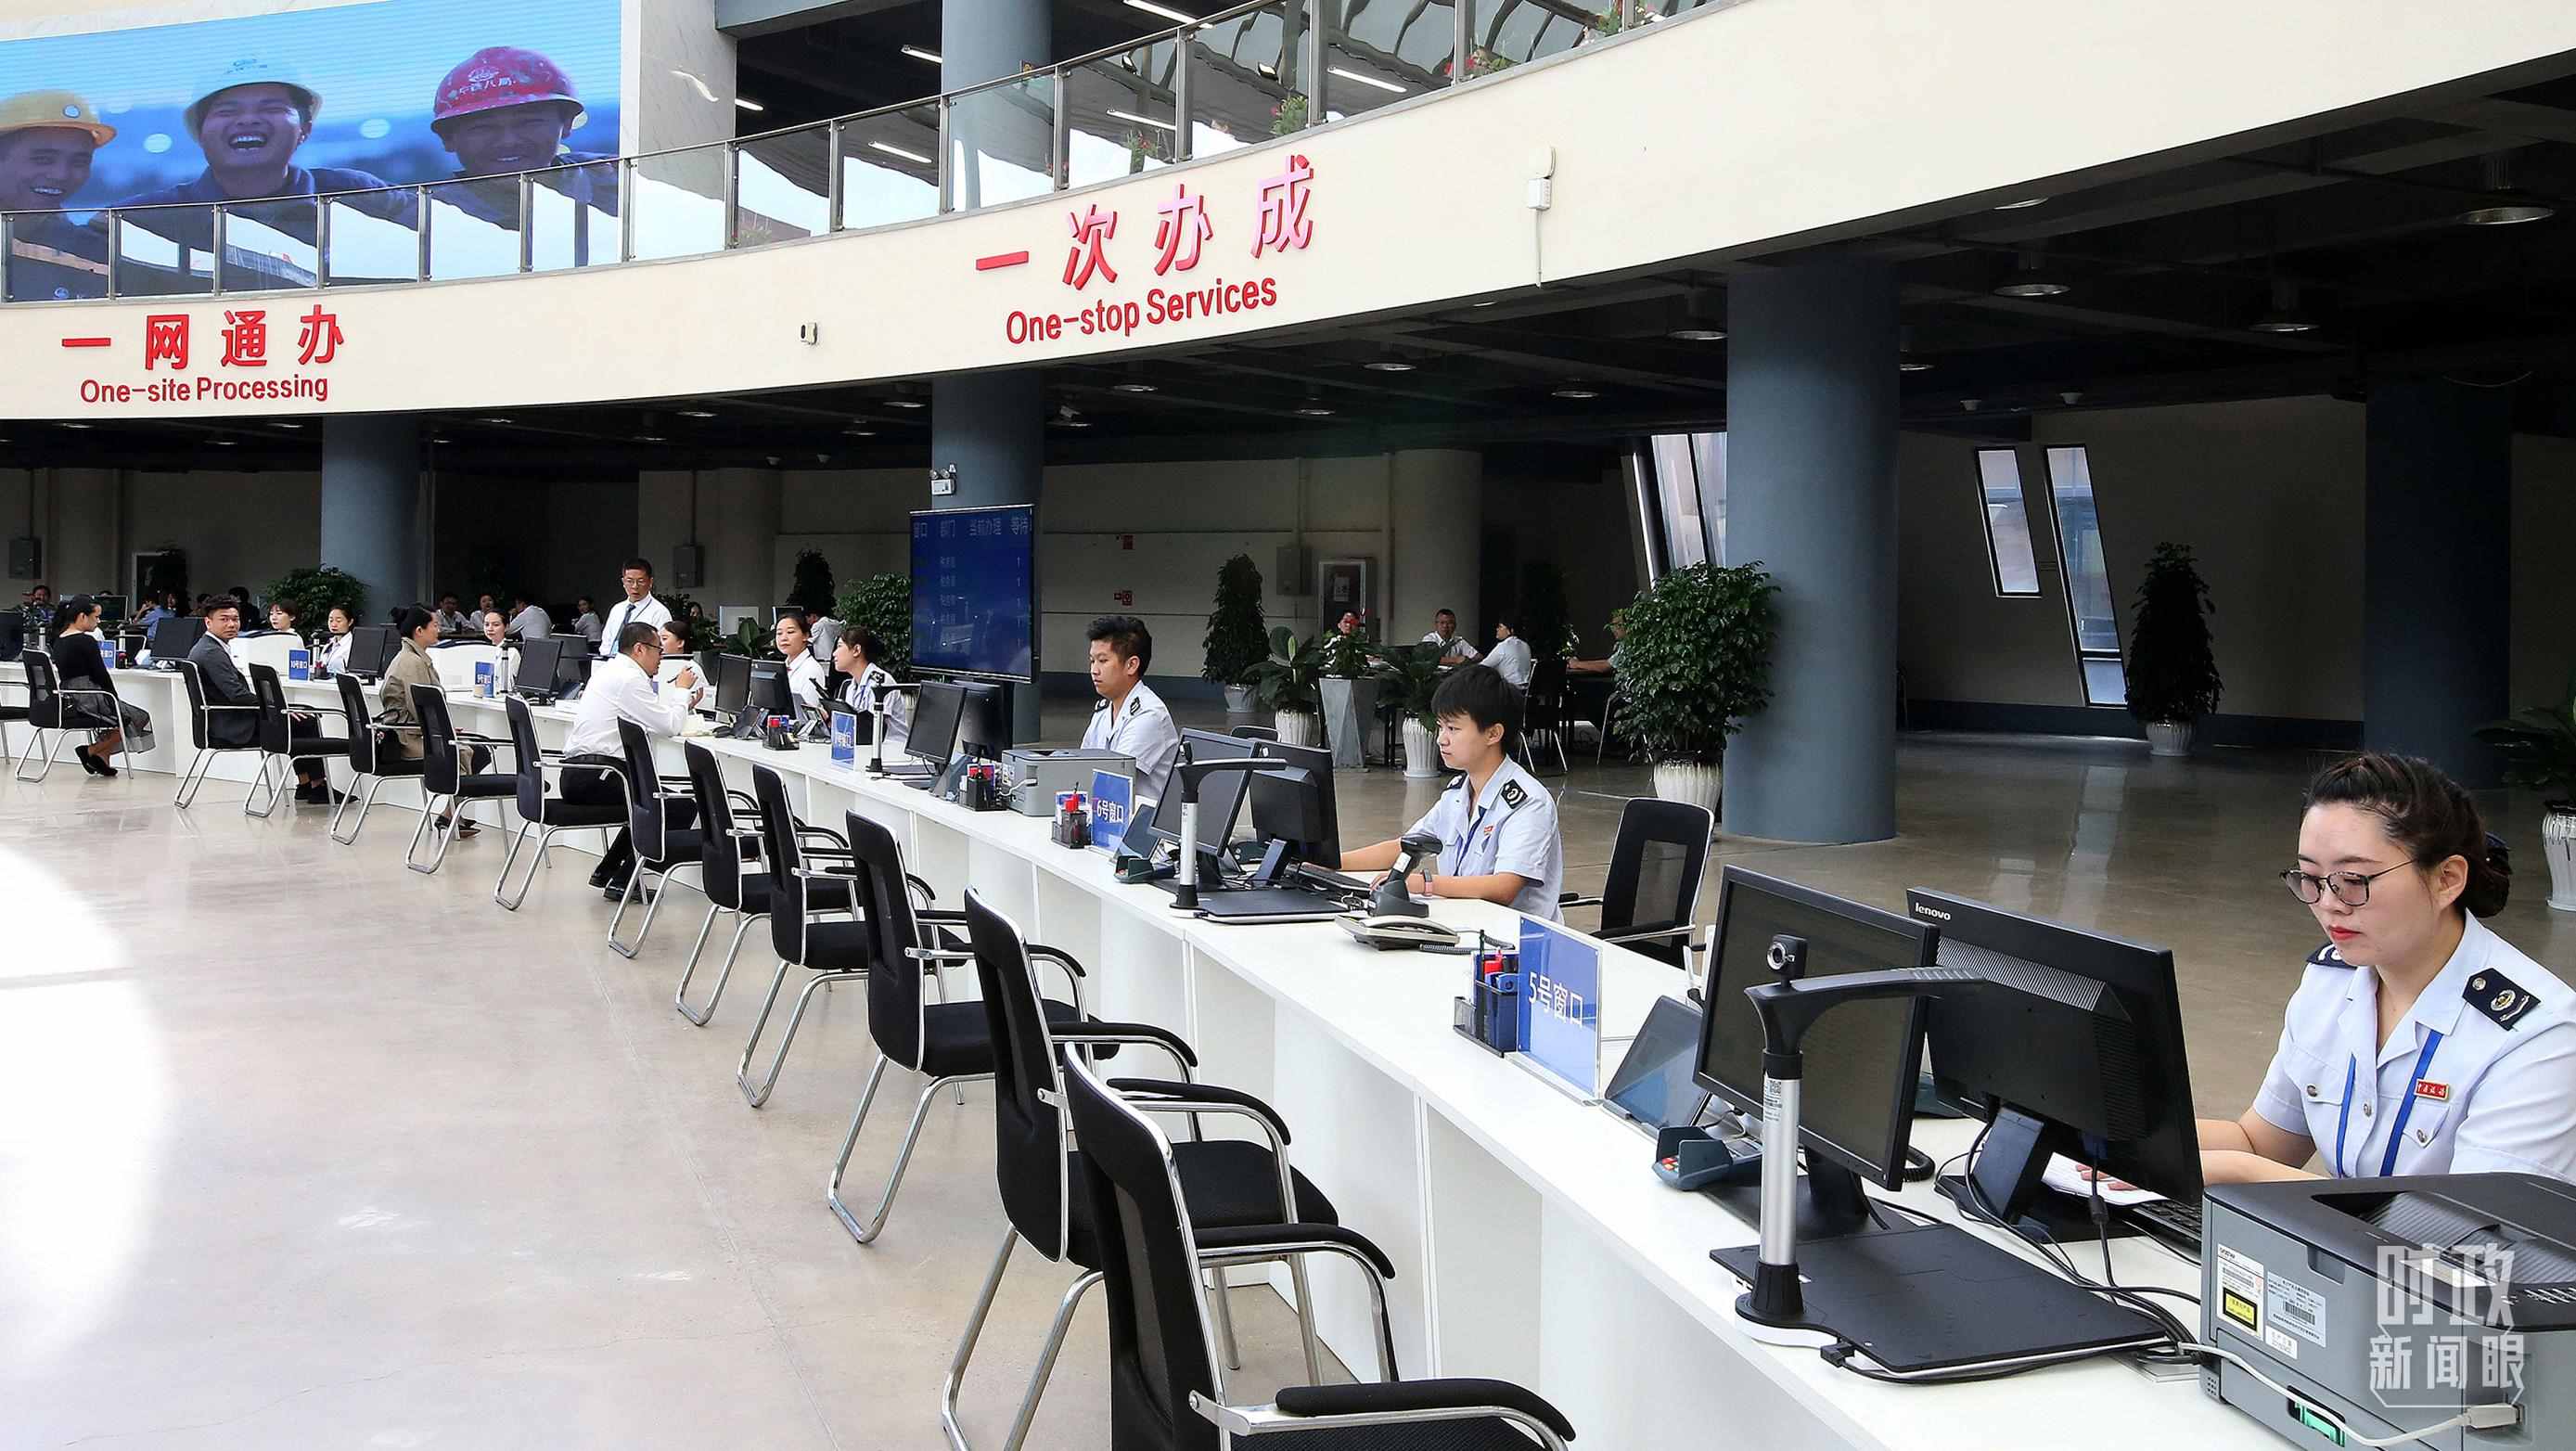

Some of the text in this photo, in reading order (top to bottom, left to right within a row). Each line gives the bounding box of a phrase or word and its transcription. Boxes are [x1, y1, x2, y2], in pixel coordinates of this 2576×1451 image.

[976, 154, 1314, 290] 一次办成
[61, 304, 344, 370] 一网通办
[1006, 277, 1277, 344] One-stop Services
[80, 374, 328, 403] One-site Processing
[1096, 799, 1124, 824] 6号窗口
[1915, 902, 1952, 920] lenovo
[1529, 971, 1583, 1029] 5号窗口
